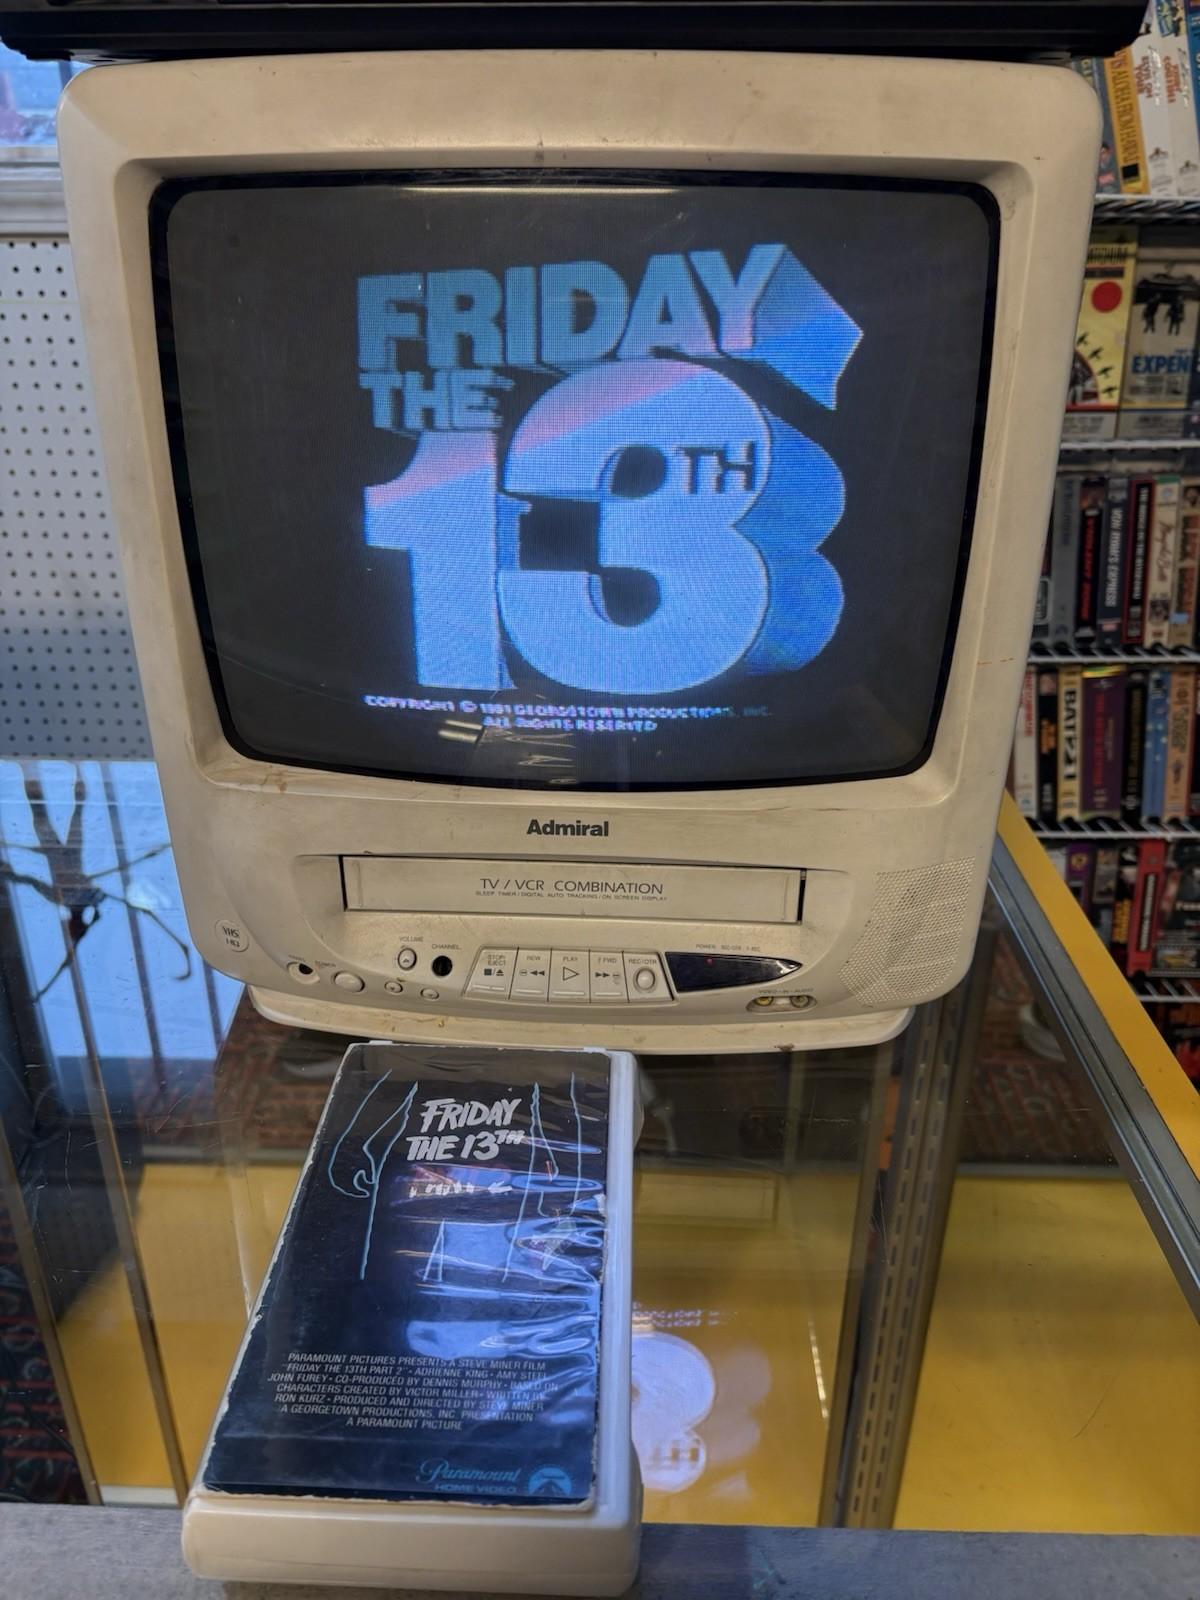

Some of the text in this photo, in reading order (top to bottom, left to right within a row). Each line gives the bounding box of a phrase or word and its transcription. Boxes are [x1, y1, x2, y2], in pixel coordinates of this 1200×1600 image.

[357, 243, 800, 371] FRIDAY
[358, 368, 510, 432] THE
[526, 818, 609, 837] Admiral
[480, 878, 499, 890] TV
[514, 879, 545, 891] VCR
[554, 880, 663, 894] COMBINATION
[222, 925, 240, 939] VHS
[420, 1098, 522, 1133] FRIDAY
[405, 1135, 462, 1161] THE
[287, 1352, 546, 1370] PARAMOUNT PICTURES PRESENTS A STEVE MINER FILM
[324, 1364, 341, 1374] THE
[344, 1365, 367, 1375] 13TH
[369, 1366, 394, 1376] PART
[413, 1368, 462, 1378] ADRIENNE
[465, 1369, 489, 1379] KING
[496, 1370, 518, 1380] AMY
[267, 1373, 293, 1382] JOHN
[296, 1374, 328, 1384] FUREY
[335, 1375, 404, 1386] CO-PRODUCED
[407, 1377, 419, 1386] BY
[422, 1378, 459, 1388] DENNIS
[461, 1380, 502, 1390] MURPHY
[276, 1383, 341, 1393] CHARACTERS
[343, 1385, 386, 1396] CREATED
[389, 1386, 403, 1397] BY
[405, 1388, 440, 1397] VICTOR
[442, 1389, 479, 1399] MILLER
[274, 1393, 545, 1412] RON KURZ PRODUCED AND DIRECTED BY STEVE MINER
[280, 1404, 288, 1414] A
[291, 1405, 359, 1416] GEORGETOWN
[346, 1417, 463, 1431] A PARAMOUNT PICTURE
[416, 1459, 522, 1484] Paramount
[434, 1483, 517, 1494] HOME VIDEO
